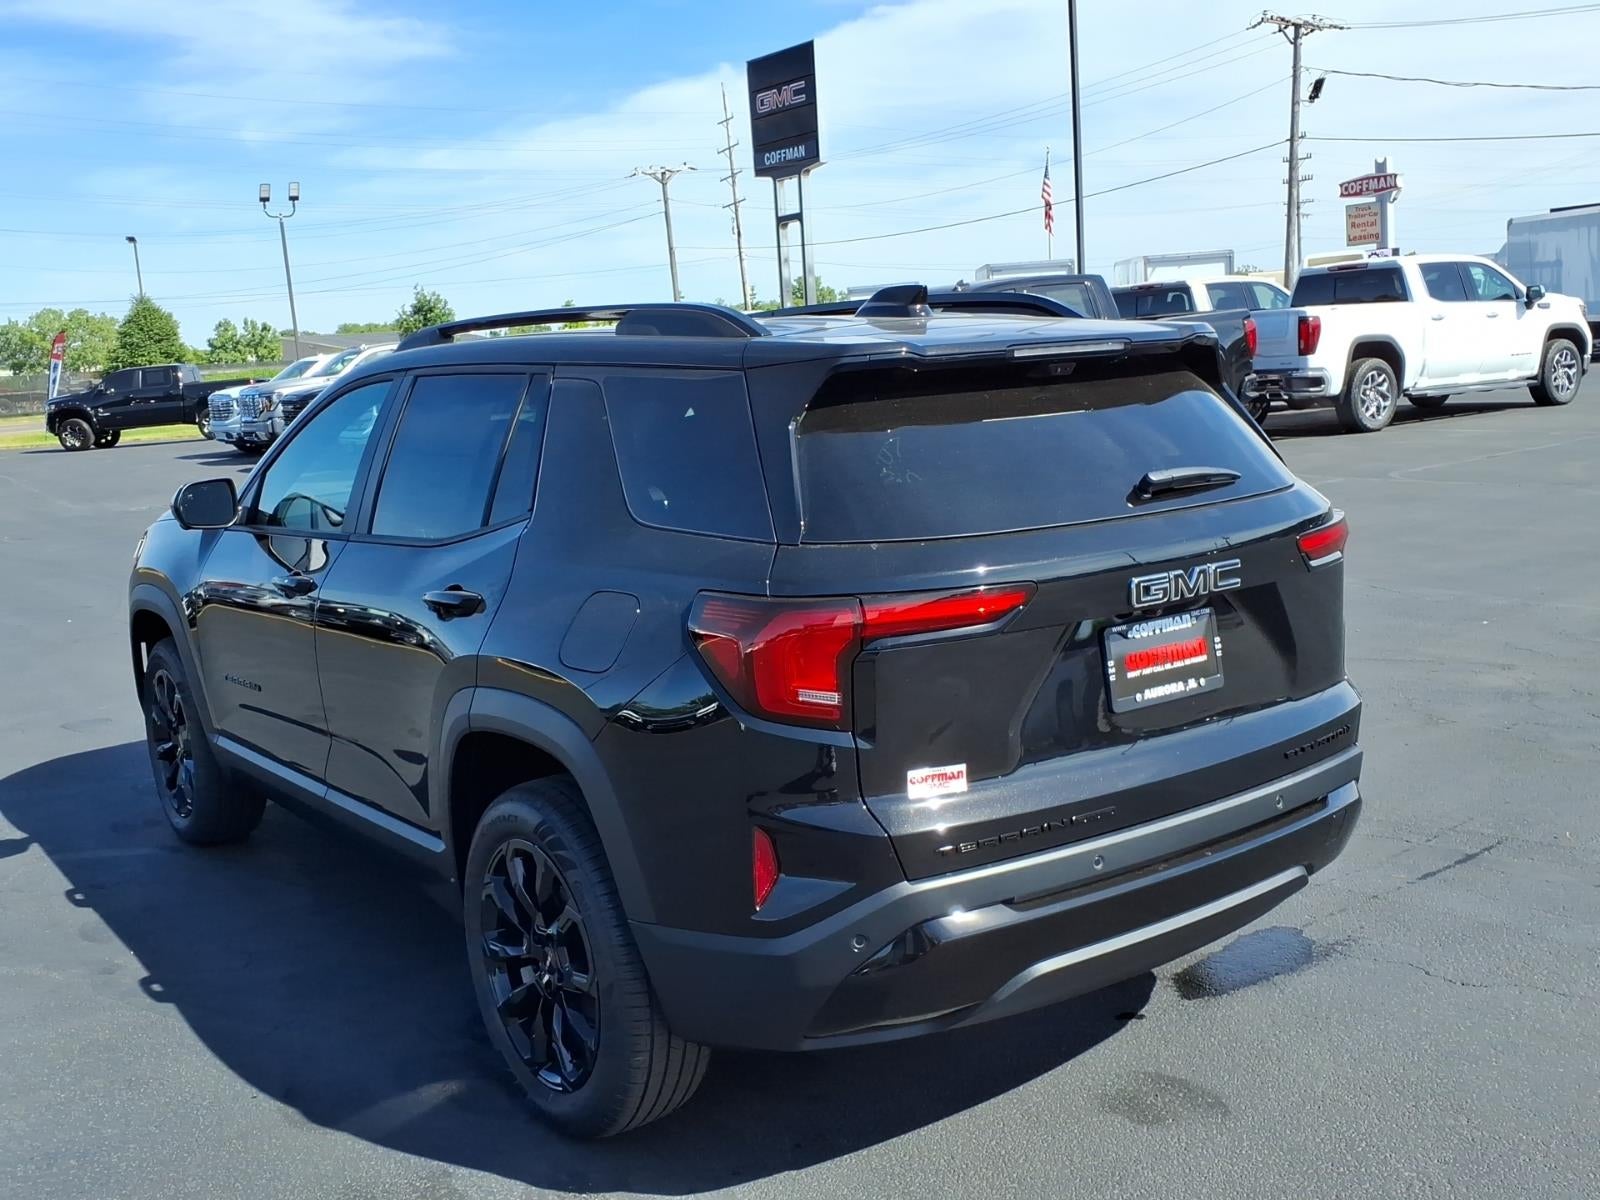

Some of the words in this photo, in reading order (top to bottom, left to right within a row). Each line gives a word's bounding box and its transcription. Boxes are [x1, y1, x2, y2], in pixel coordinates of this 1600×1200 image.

[756, 80, 806, 113] GMC
[764, 144, 806, 165] COFFMAN
[1341, 174, 1395, 195] COFFMAN
[1350, 219, 1377, 229] Rental
[1348, 232, 1380, 242] Leasing
[1130, 559, 1241, 608] GMC
[1131, 614, 1193, 638] COFFMAN
[1143, 681, 1185, 700] AURORA
[909, 769, 965, 785] COFFMAN
